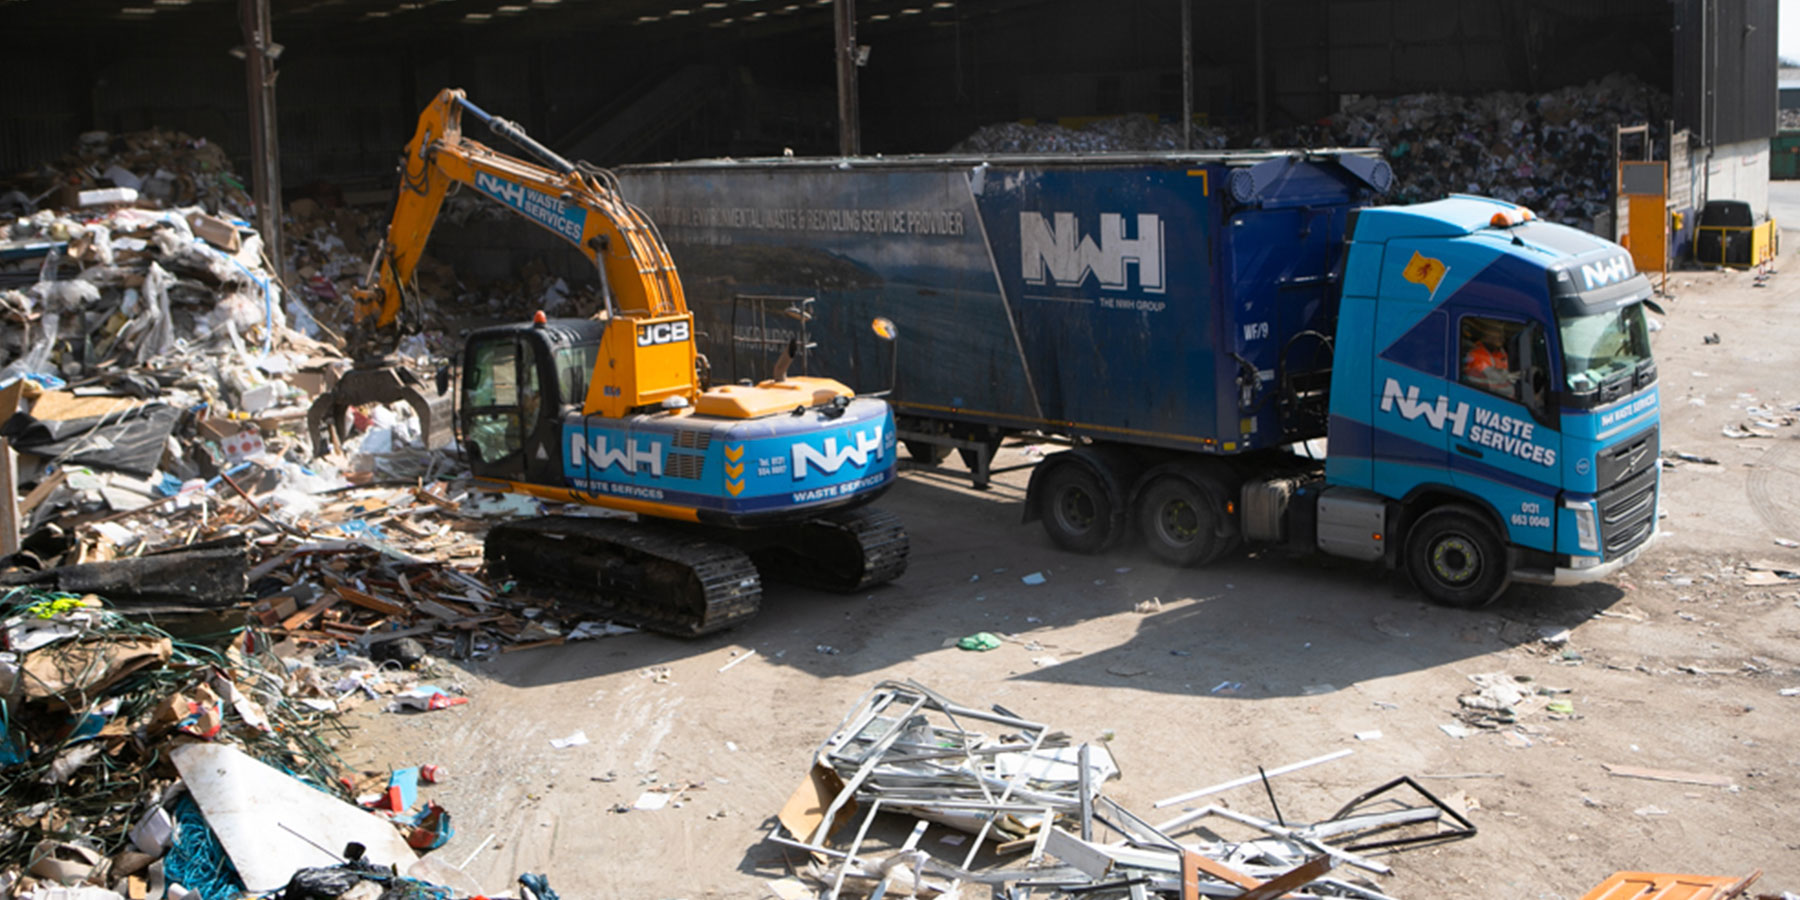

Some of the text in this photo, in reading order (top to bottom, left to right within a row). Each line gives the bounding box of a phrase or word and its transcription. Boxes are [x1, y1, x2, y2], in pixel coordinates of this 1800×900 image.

[478, 172, 526, 208] NWH
[526, 189, 566, 215] WASTE
[524, 201, 582, 240] SERVICES
[808, 209, 860, 232] RECYCLING
[861, 209, 906, 234] SERVICE
[907, 211, 964, 235] PROVIDER
[1020, 211, 1166, 293] NWH
[1581, 254, 1630, 291] NWH
[1099, 297, 1114, 308] THE
[1136, 300, 1166, 312] GROUP
[637, 321, 689, 346] JCB
[1243, 322, 1269, 341] WF/9
[1380, 377, 1470, 437] NWH
[1475, 407, 1534, 440] WASTE
[572, 432, 661, 475] NWH
[791, 425, 884, 480] NWH
[1469, 425, 1556, 467] SERVICES
[574, 479, 664, 499] WASTE SERVICES
[793, 472, 885, 502] WASTE SERVICES
[1521, 501, 1540, 514] 0131
